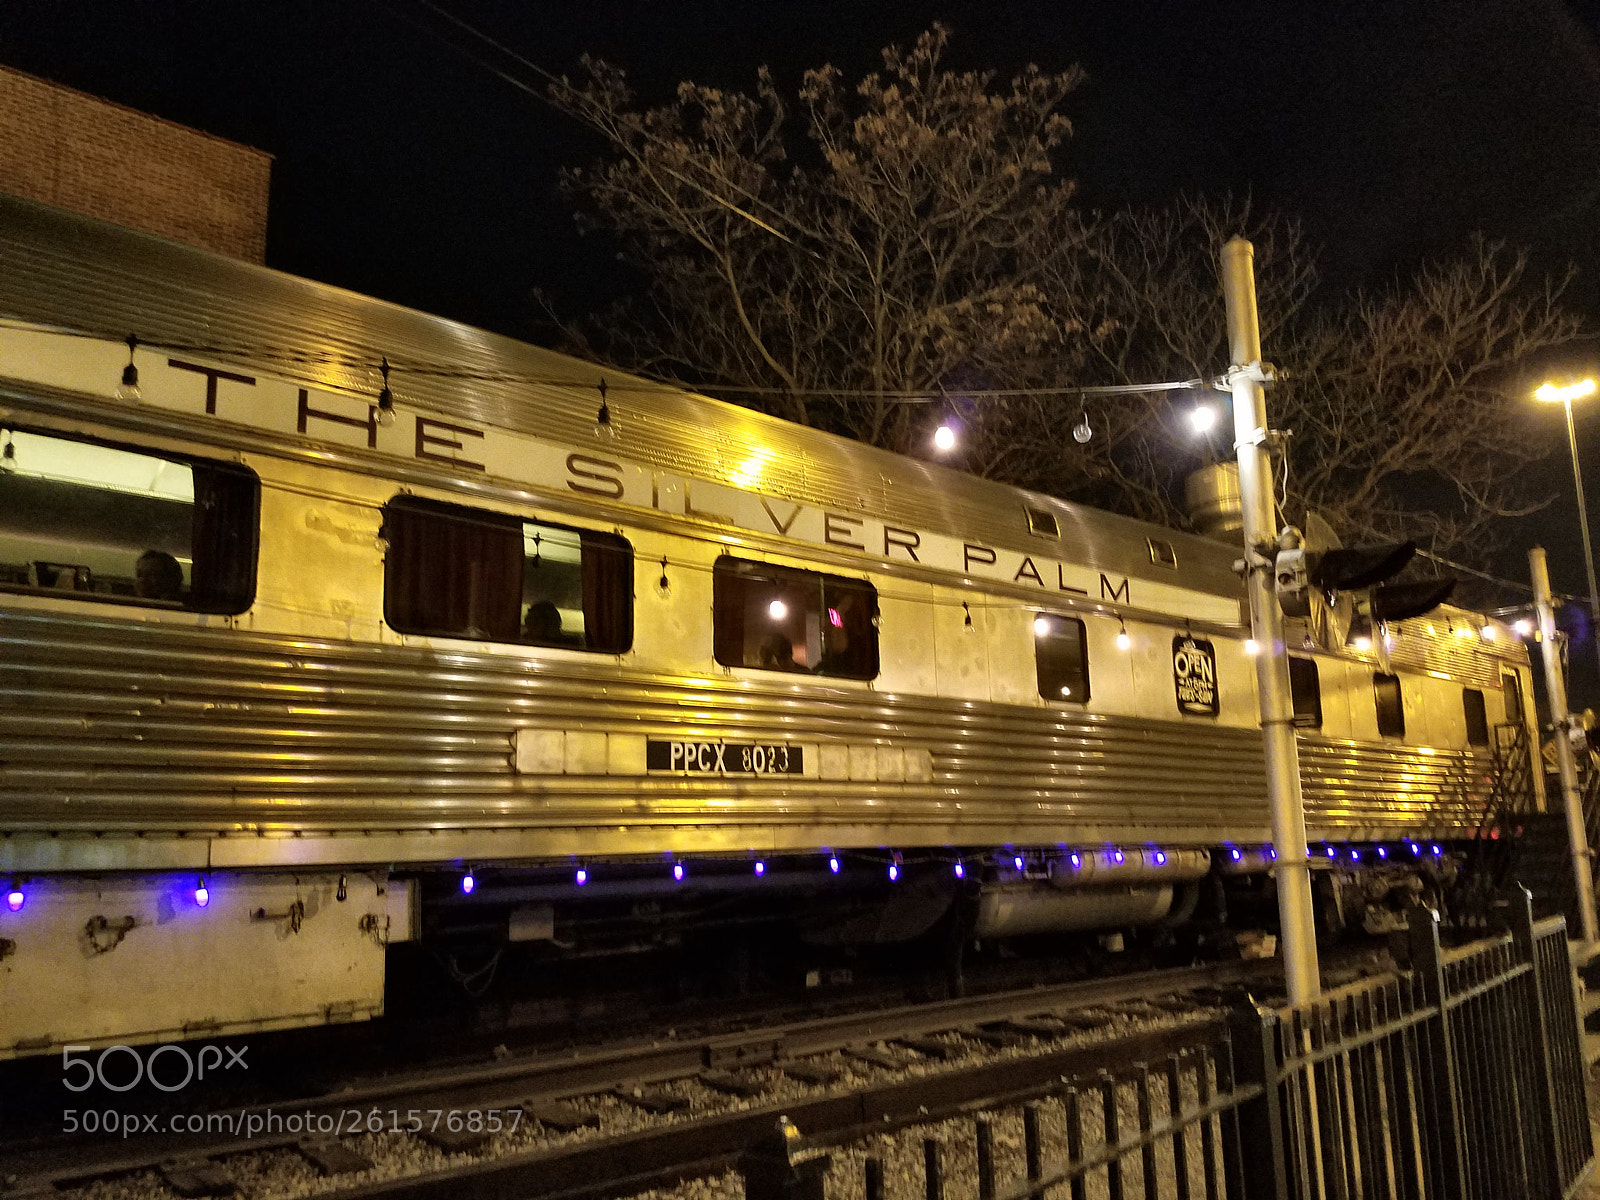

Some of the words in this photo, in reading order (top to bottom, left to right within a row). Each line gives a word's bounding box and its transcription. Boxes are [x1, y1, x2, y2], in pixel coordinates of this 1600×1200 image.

[168, 358, 486, 473] THE
[565, 452, 923, 563] SILVER
[963, 543, 1131, 605] PALM
[1175, 650, 1214, 683] OPEN
[670, 741, 727, 773] PPCX
[742, 744, 790, 774] 8023
